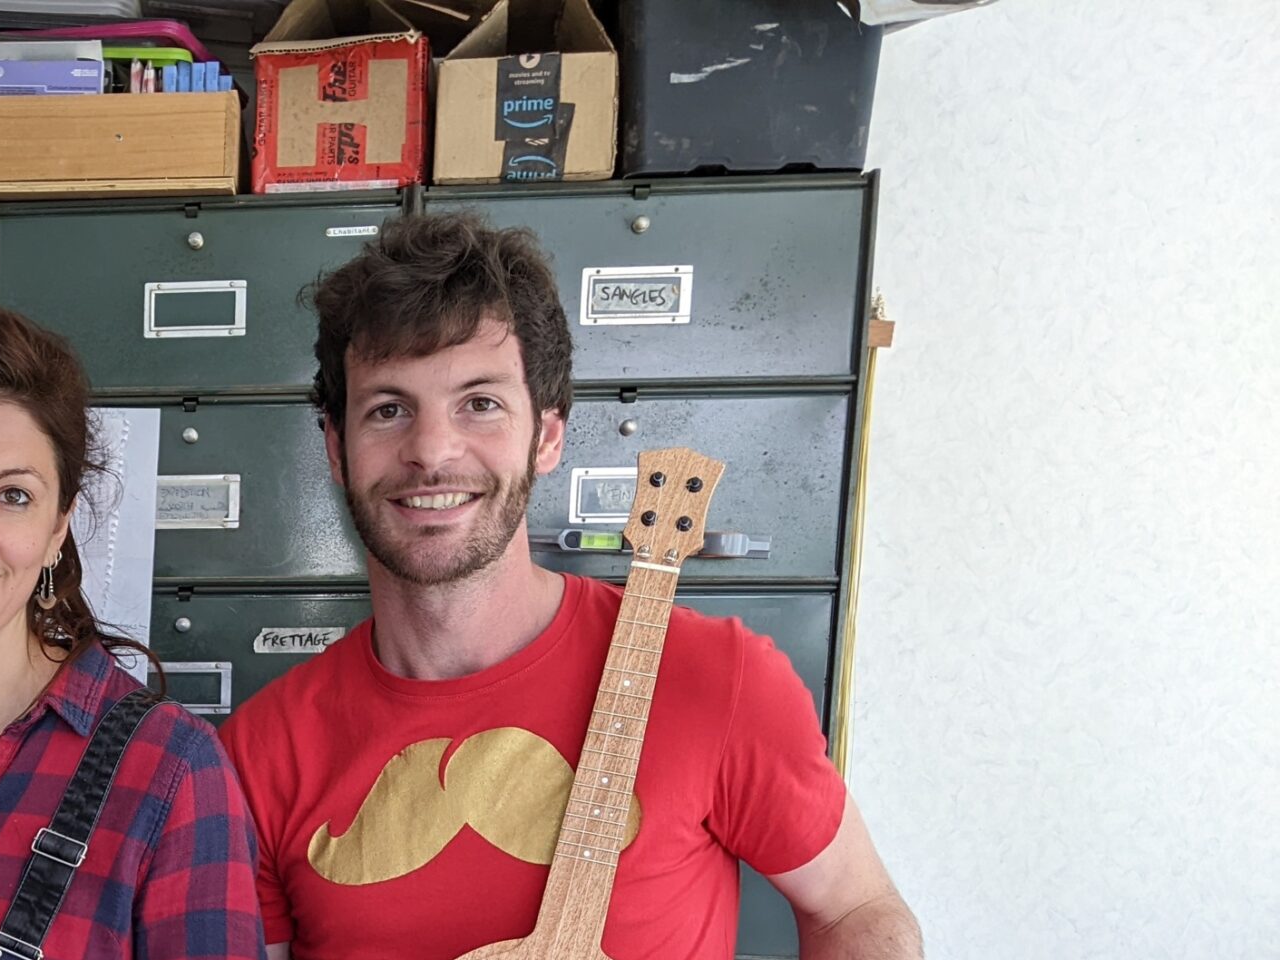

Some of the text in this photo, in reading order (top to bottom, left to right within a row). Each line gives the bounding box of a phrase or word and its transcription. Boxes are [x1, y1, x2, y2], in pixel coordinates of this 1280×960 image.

[514, 78, 545, 86] streaming
[503, 96, 554, 116] prime
[327, 136, 336, 165] PARTS
[600, 285, 666, 306] SANGLES
[262, 631, 333, 647] FRETTAGE
